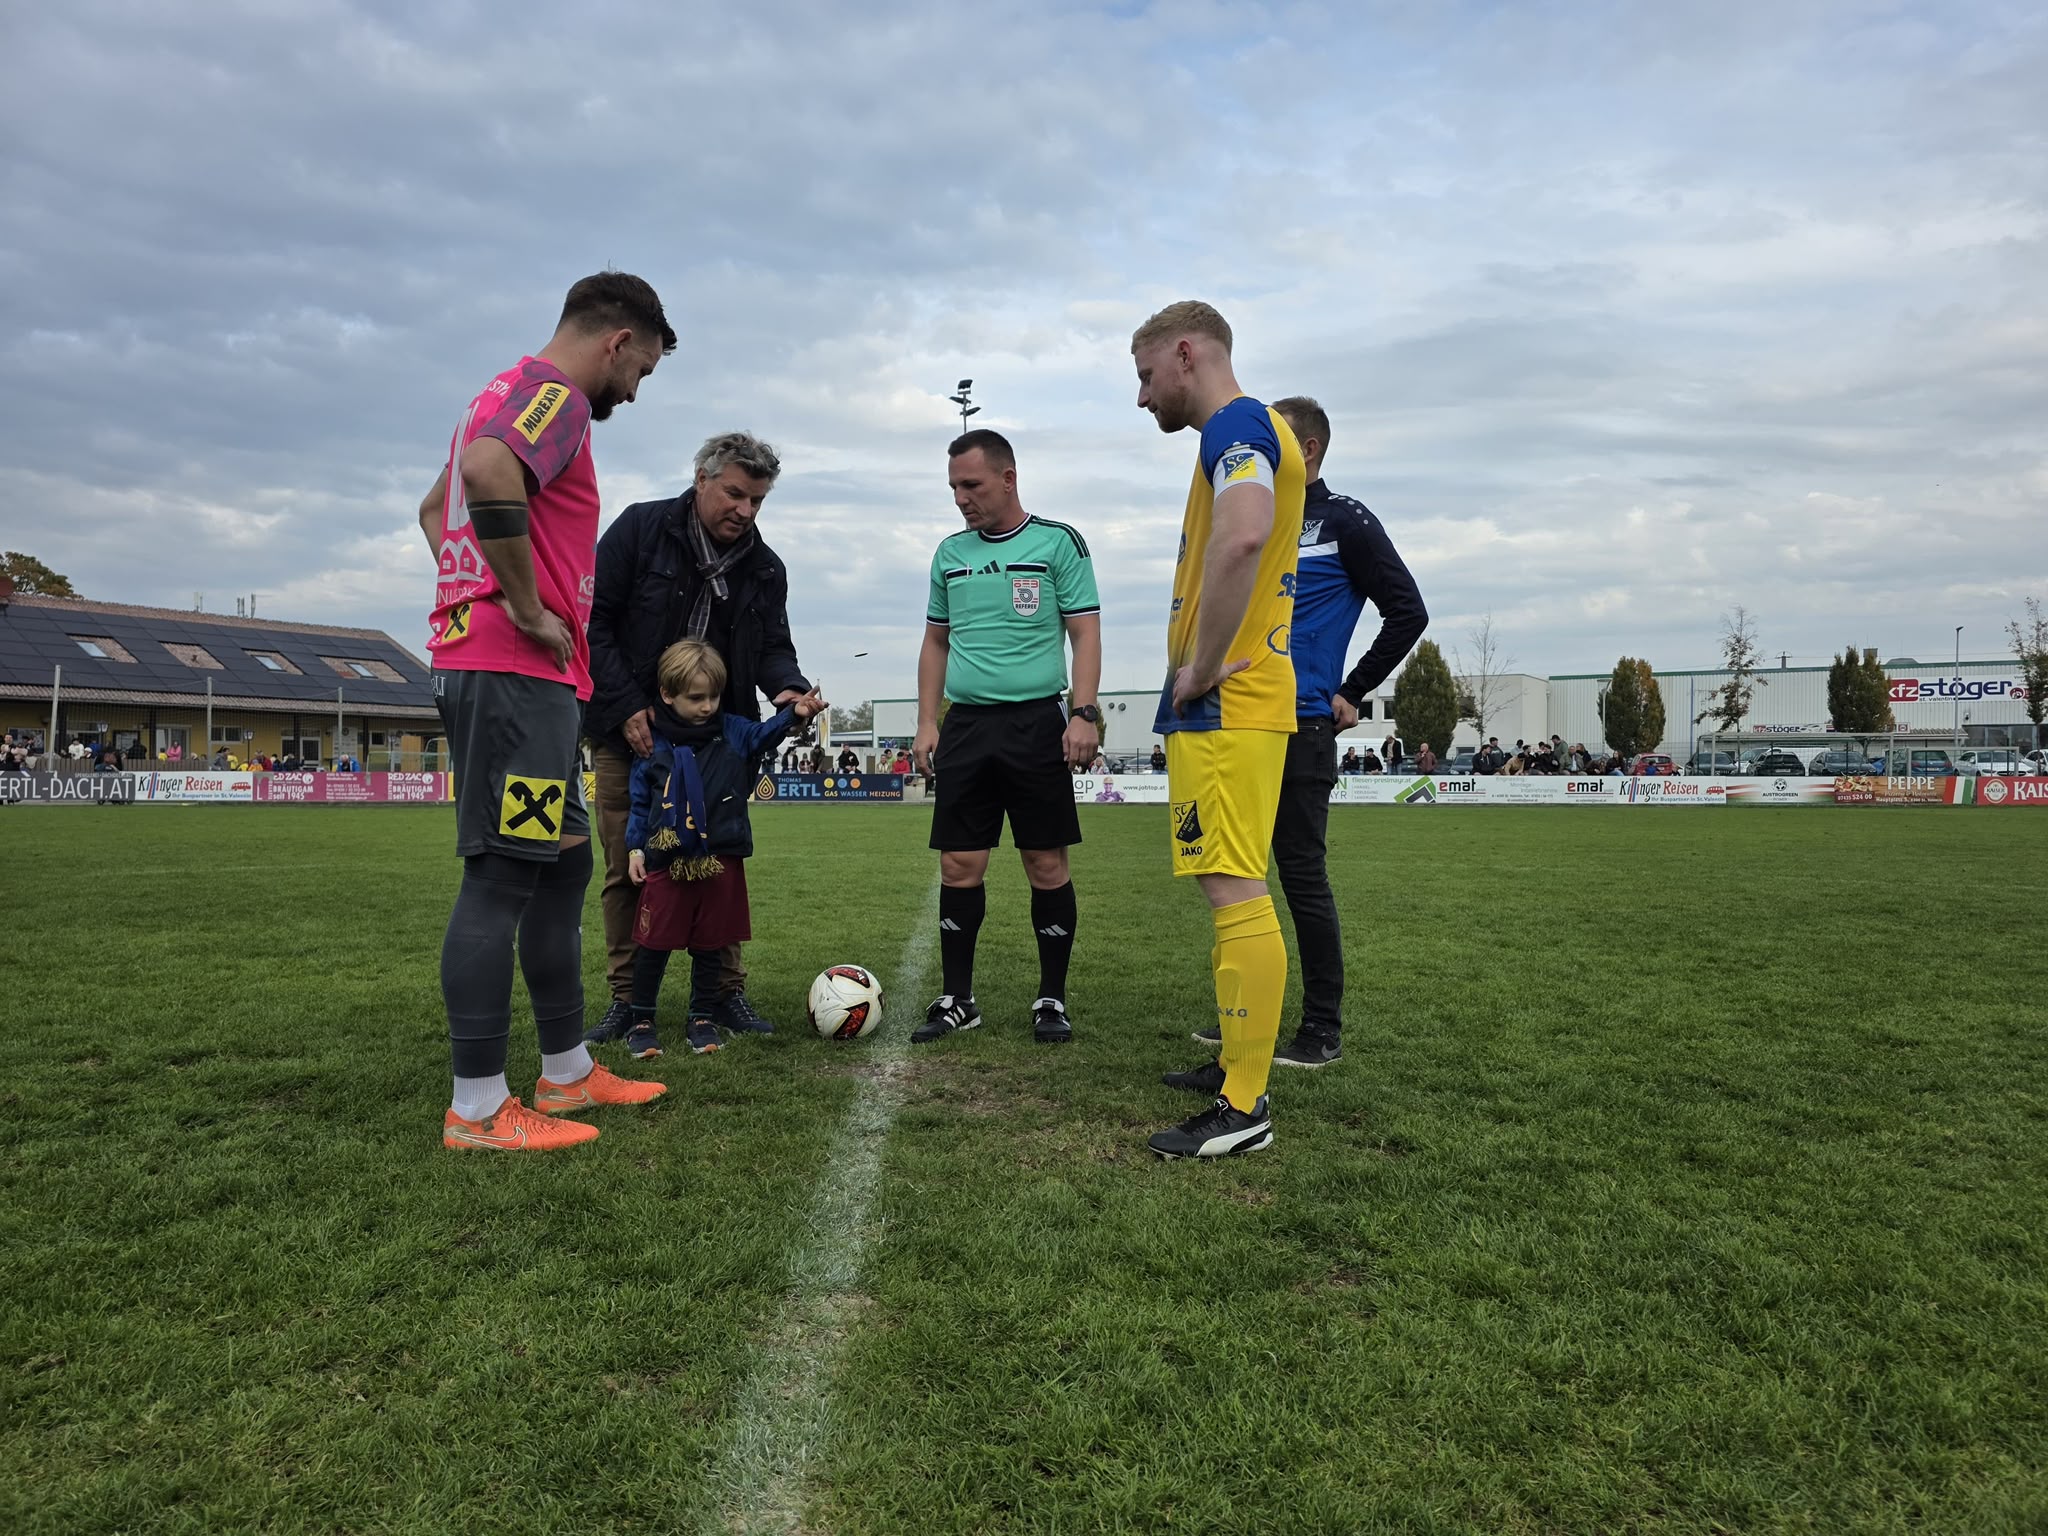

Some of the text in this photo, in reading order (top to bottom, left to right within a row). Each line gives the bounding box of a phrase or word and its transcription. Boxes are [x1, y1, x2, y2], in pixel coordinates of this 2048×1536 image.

[522, 386, 562, 435] MUREXIN
[1919, 677, 2013, 700] stöger
[1766, 724, 1800, 733] stöger
[285, 773, 303, 781] ZAC
[387, 773, 422, 781] RED ZAC
[1887, 776, 1935, 790] PEPPE
[137, 772, 223, 798] Killinger Reisen
[273, 784, 314, 793] BRÄUTIGAM
[392, 784, 433, 793] BRÄUTIGAM
[778, 783, 821, 797] ERTL
[1439, 778, 1476, 792] emat
[1567, 778, 1604, 792] emat
[1619, 777, 1699, 802] Killinger Reisen
[273, 792, 305, 800] seit 1945
[392, 792, 425, 800] seit 1945
[1180, 846, 1203, 857] JAKO
